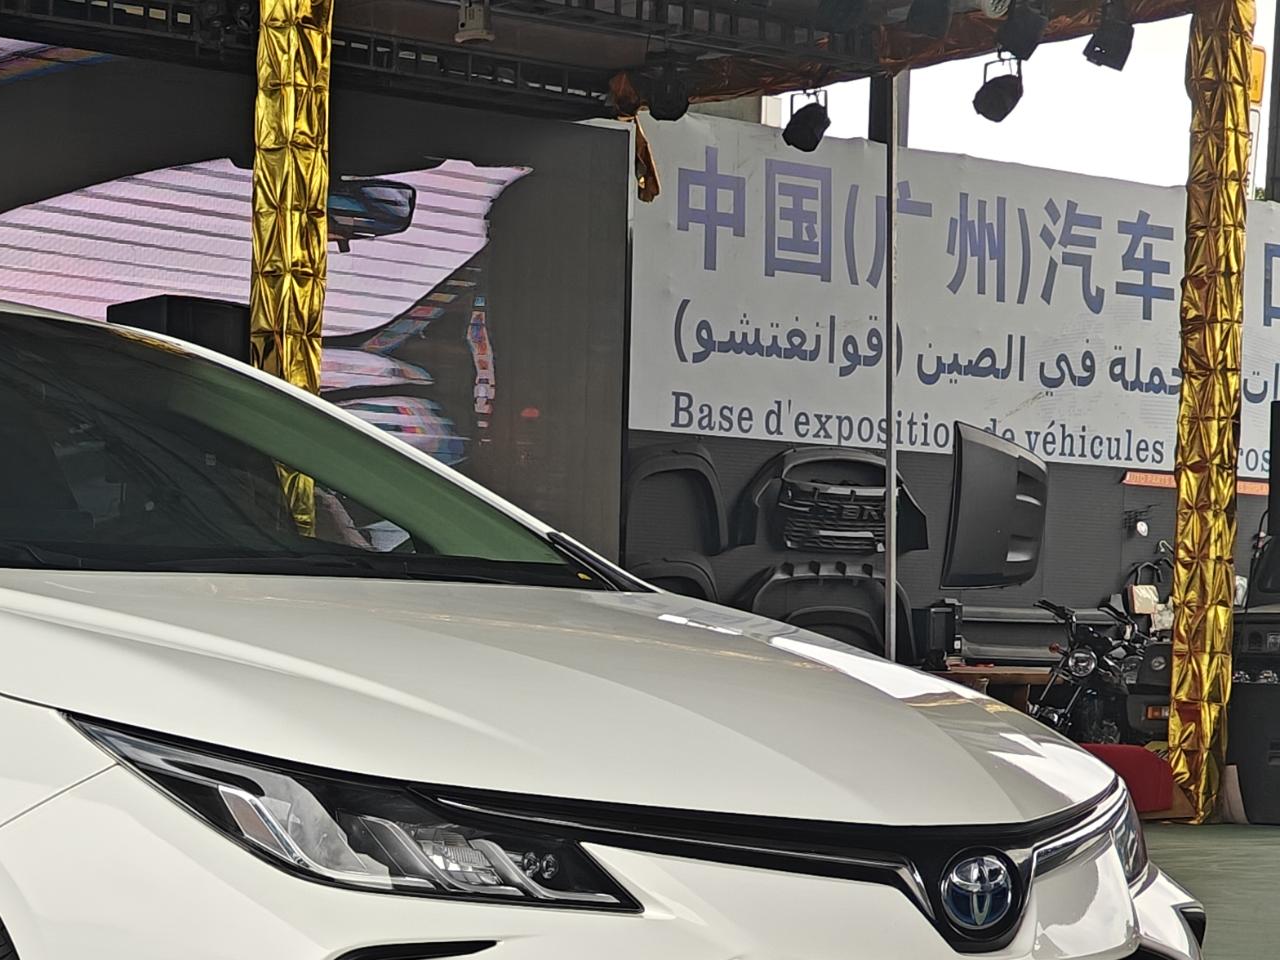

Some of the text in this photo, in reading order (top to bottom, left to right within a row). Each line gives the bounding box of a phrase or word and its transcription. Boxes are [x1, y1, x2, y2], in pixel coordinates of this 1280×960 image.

[917, 333, 1026, 386] الصين
[1039, 338, 1096, 397] في
[670, 391, 754, 435] Base
[765, 399, 950, 448] d'expositio
[1025, 420, 1165, 464] véhicules
